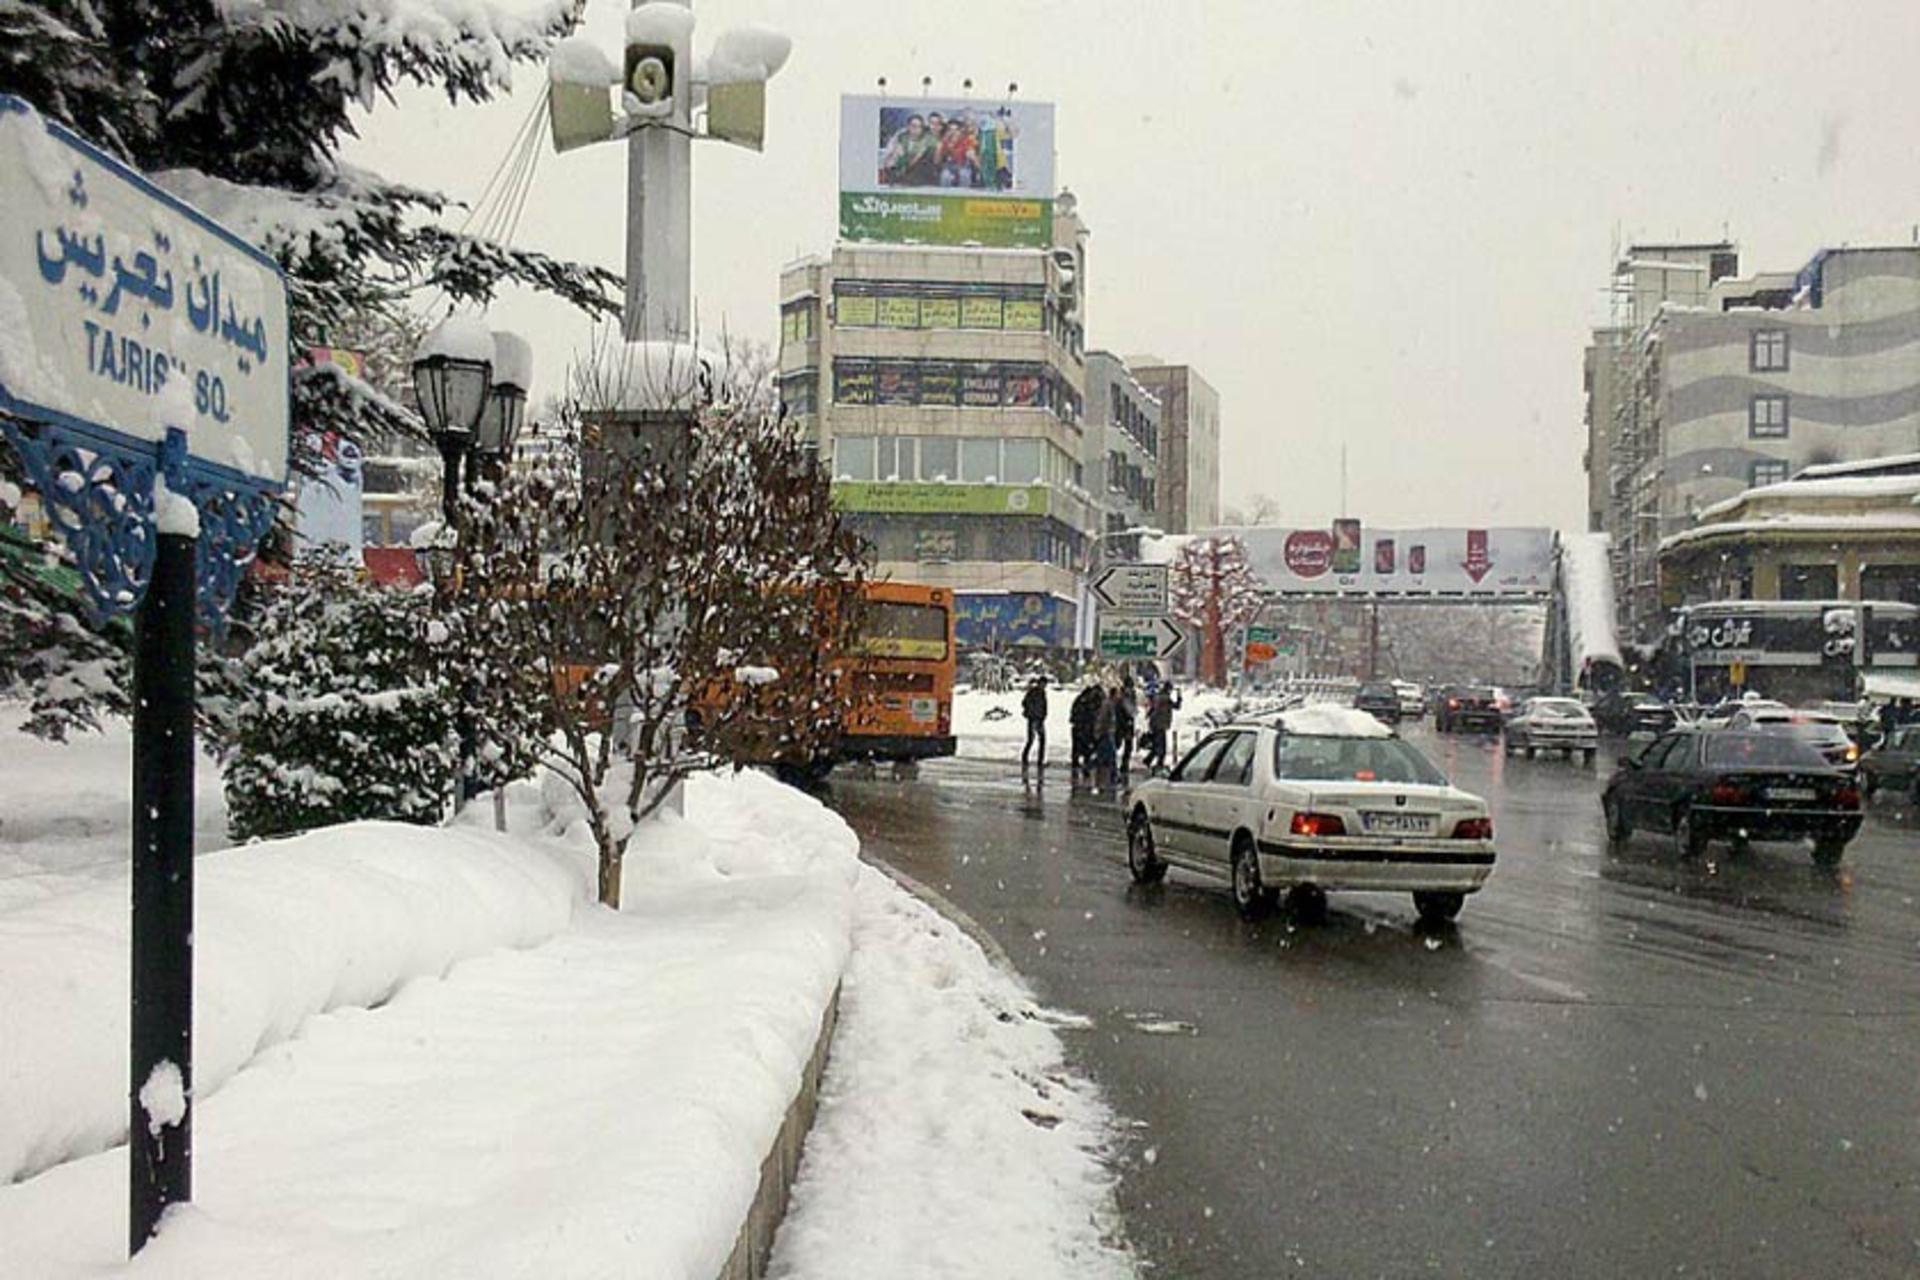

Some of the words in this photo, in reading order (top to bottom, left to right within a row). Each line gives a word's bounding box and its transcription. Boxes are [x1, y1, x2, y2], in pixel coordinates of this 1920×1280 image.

[37, 169, 174, 329] تجریش
[84, 320, 187, 394] TAJRIS
[187, 254, 267, 374] میدان
